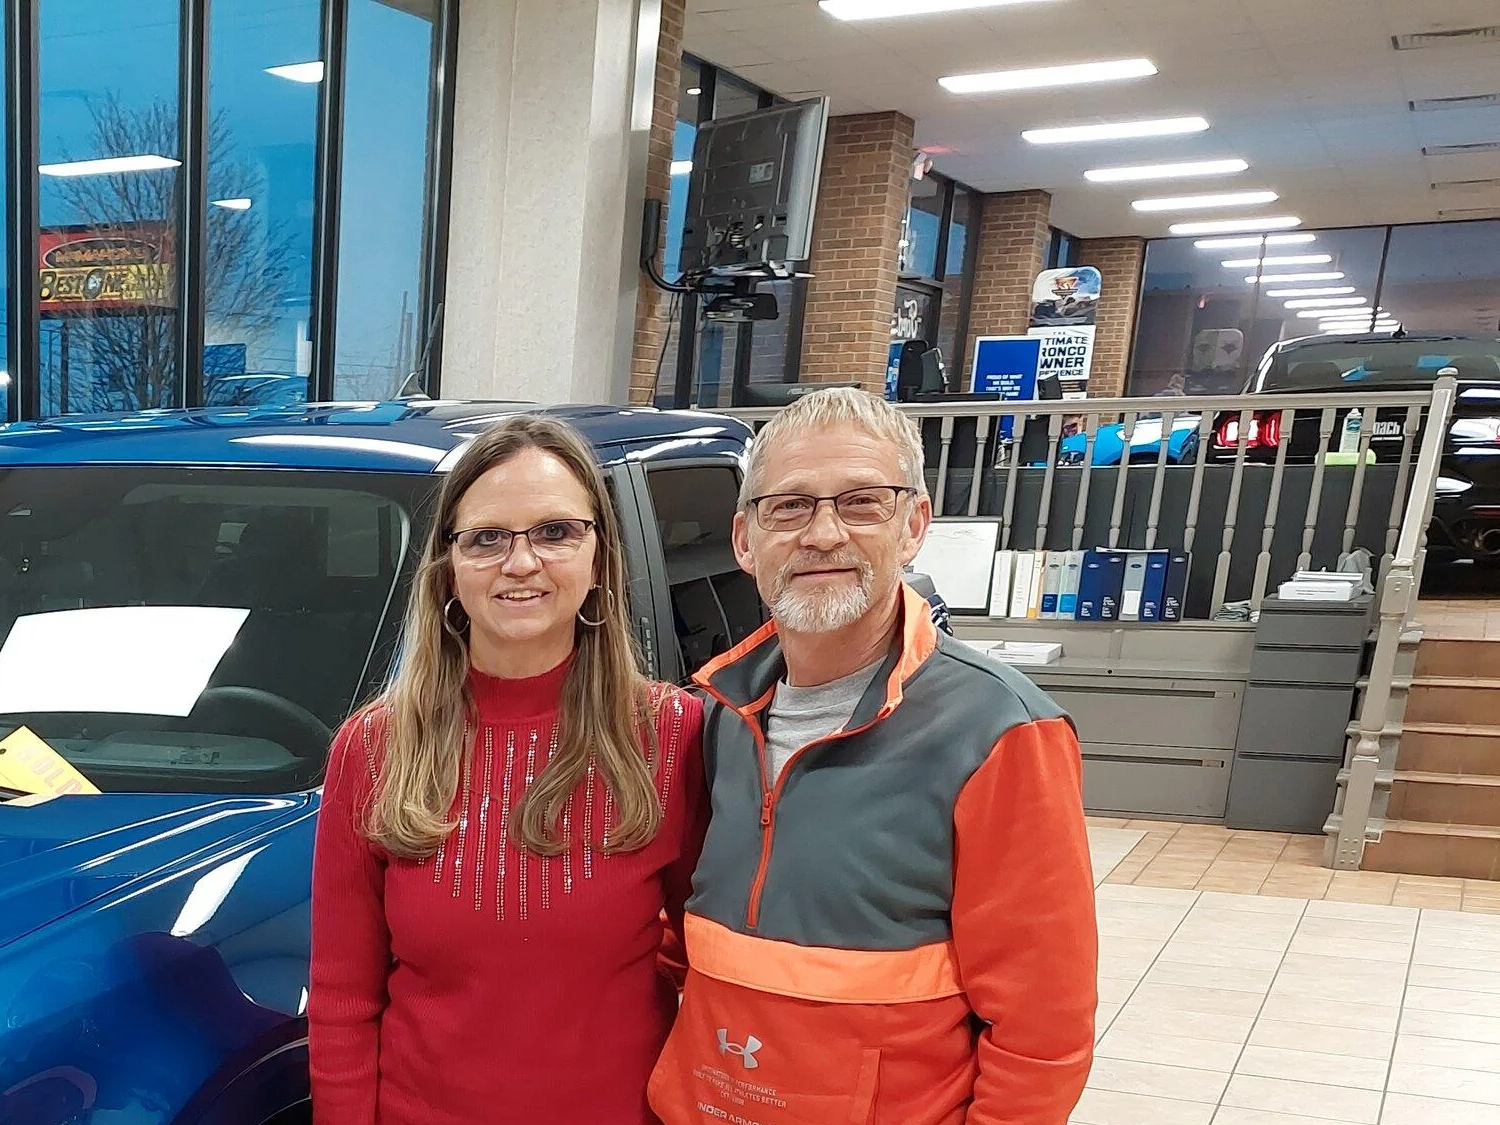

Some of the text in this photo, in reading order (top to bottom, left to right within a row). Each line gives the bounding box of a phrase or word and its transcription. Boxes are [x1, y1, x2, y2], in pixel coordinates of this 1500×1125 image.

[1045, 336, 1088, 345] TIMATE
[1040, 357, 1085, 368] WNER
[761, 1096, 787, 1108] BETTER
